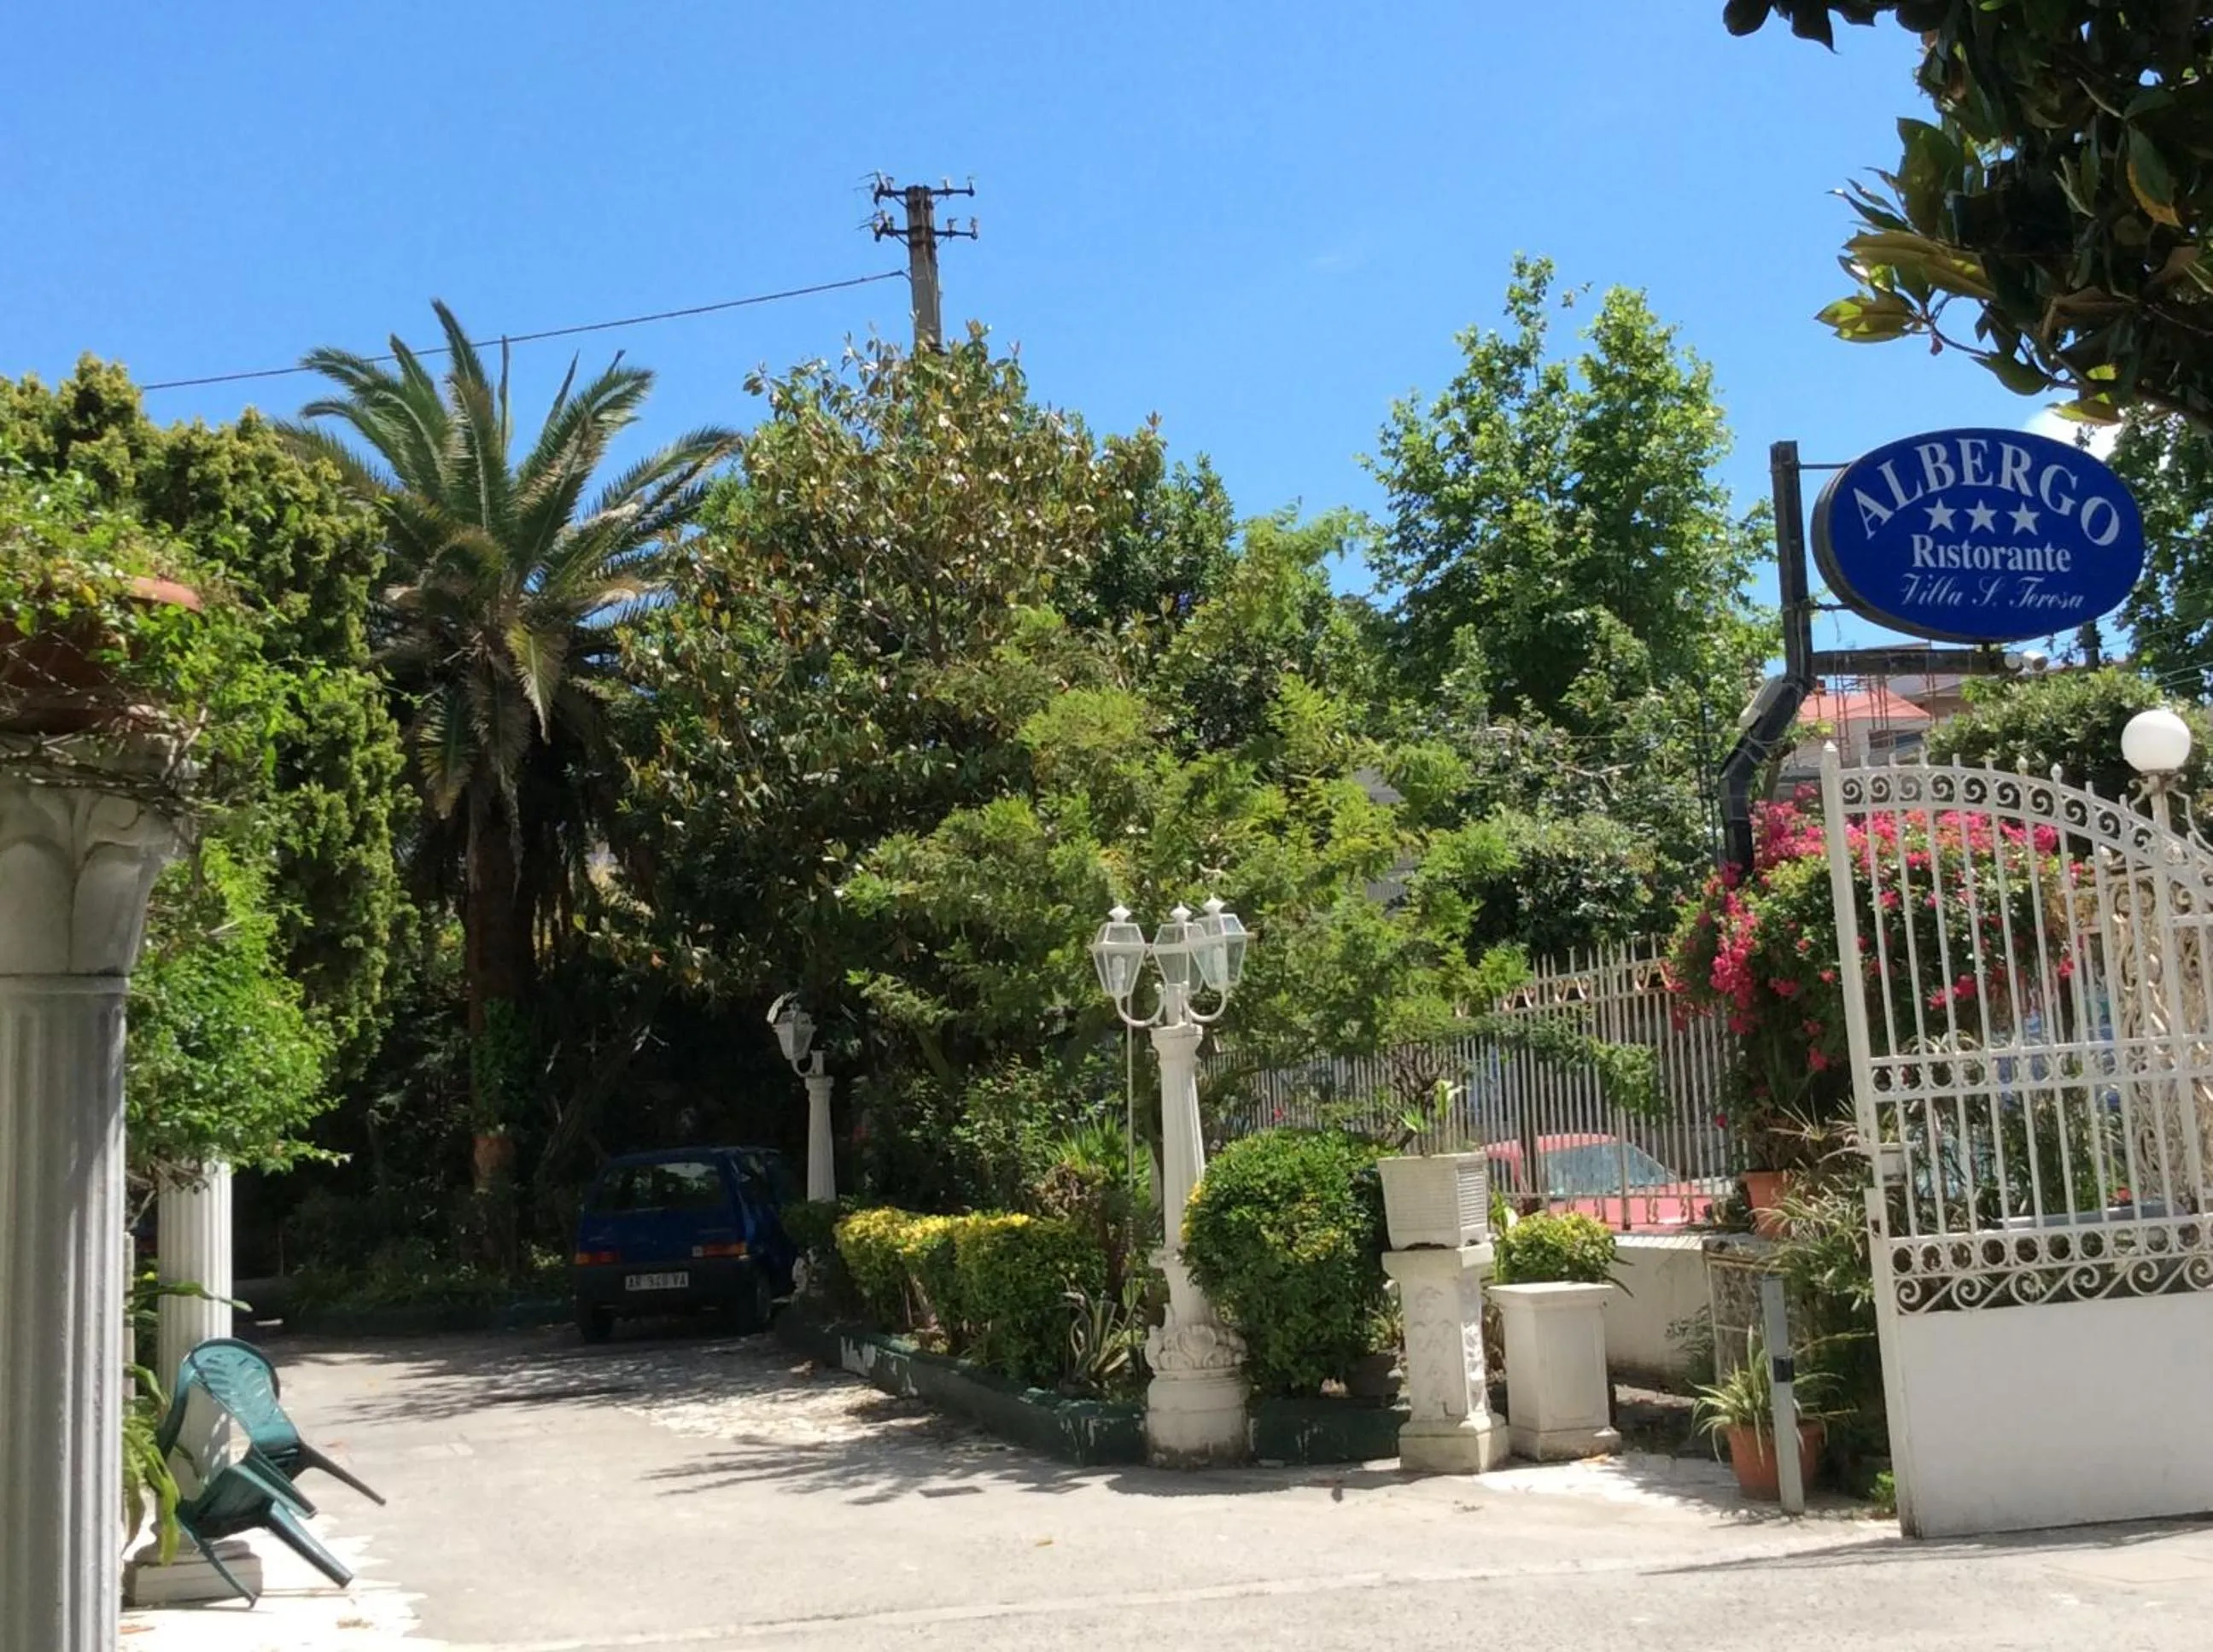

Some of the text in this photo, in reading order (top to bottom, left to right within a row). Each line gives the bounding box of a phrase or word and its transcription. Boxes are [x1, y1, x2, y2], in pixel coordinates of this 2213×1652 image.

[1852, 438, 2121, 546] ALBERGO
[1912, 533, 2071, 572] Ristorante
[1900, 573, 1965, 607] Villa
[2009, 575, 2085, 610] Teresa
